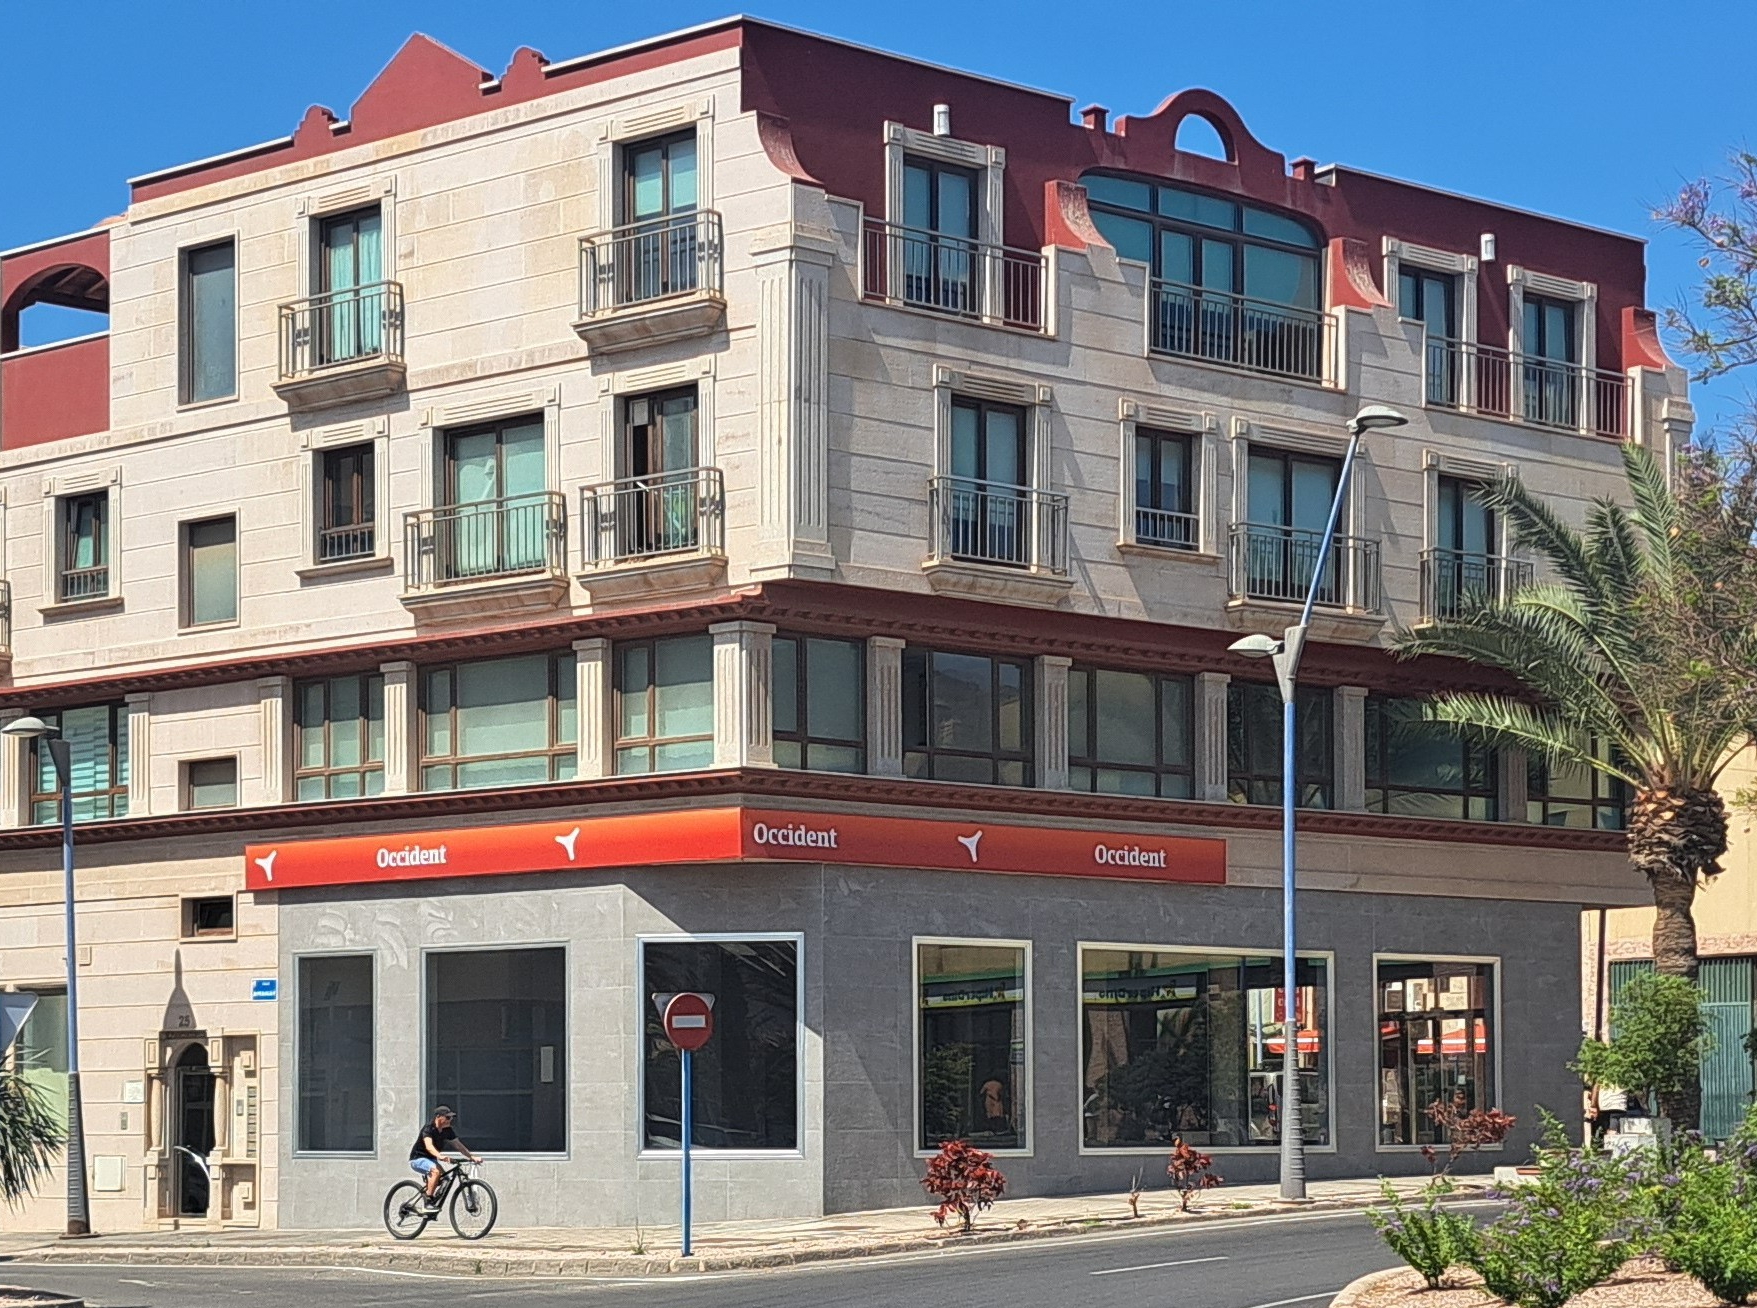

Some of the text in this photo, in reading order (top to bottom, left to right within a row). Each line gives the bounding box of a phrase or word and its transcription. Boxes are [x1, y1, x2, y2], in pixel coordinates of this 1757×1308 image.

[753, 822, 838, 849] Occident
[376, 844, 447, 868] Occident
[1094, 844, 1167, 868] Occident
[178, 1014, 191, 1028] 25
